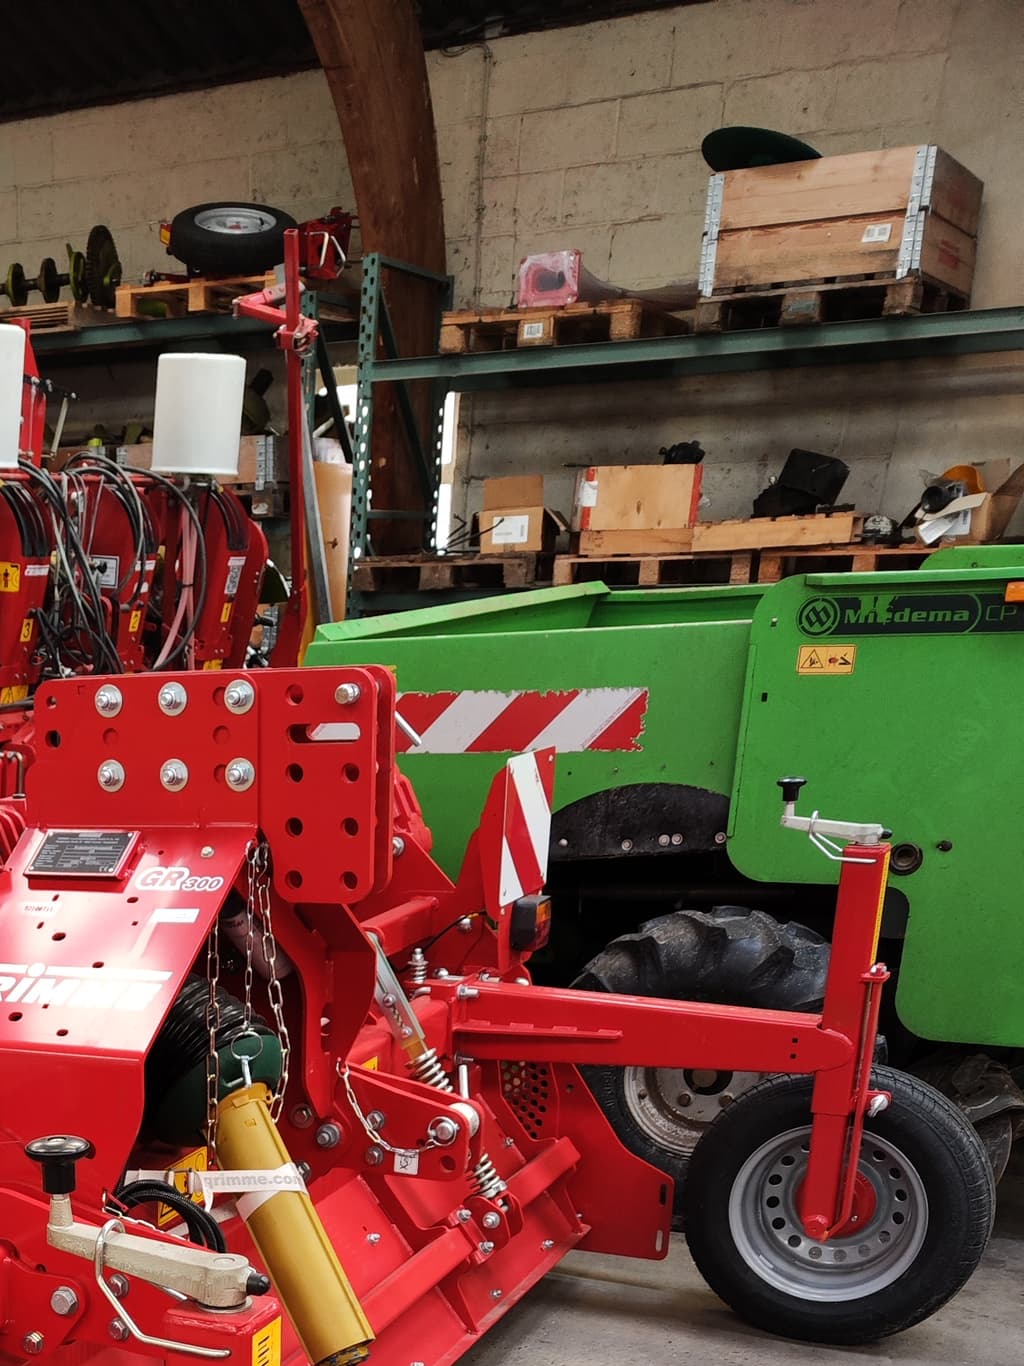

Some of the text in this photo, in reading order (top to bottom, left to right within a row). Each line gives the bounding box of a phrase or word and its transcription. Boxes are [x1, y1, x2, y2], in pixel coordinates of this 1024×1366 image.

[986, 605, 1018, 621] CP
[23, 622, 31, 639] 3
[139, 868, 222, 890] GR 300
